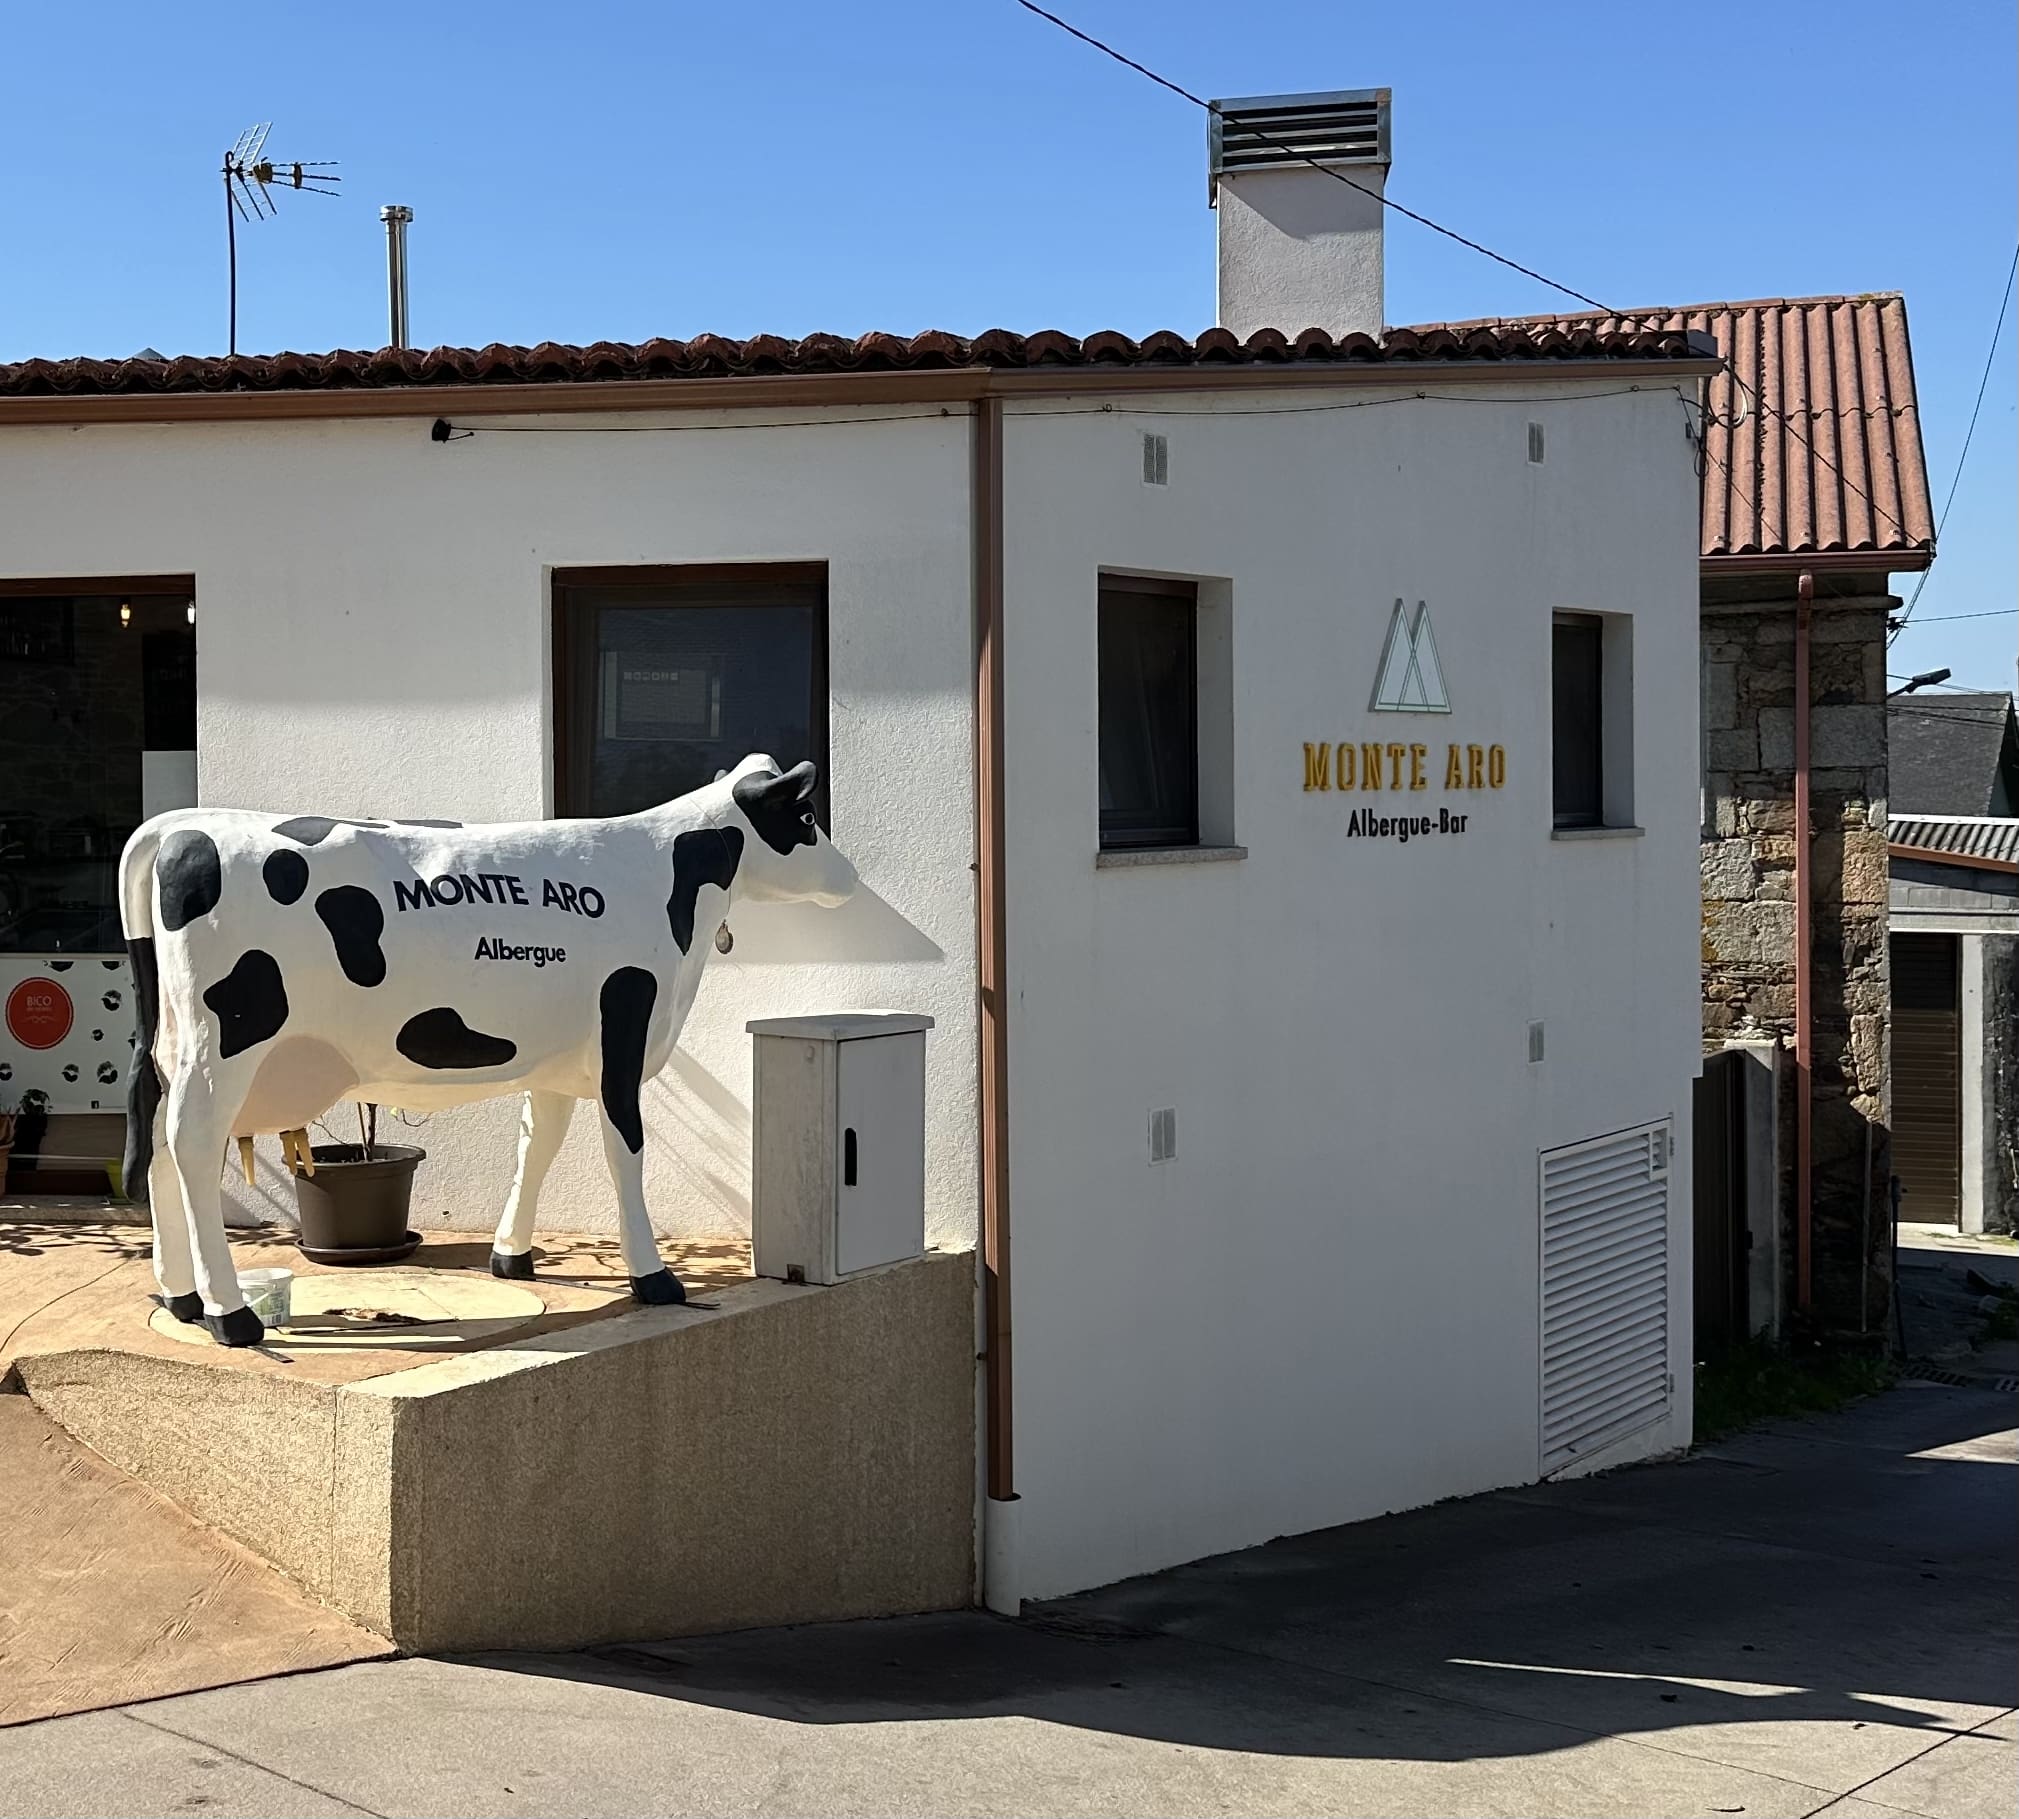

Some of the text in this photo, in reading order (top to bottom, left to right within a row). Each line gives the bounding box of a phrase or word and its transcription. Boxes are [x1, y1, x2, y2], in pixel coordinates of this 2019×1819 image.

[1303, 742, 1506, 791] MONTE ARO
[1347, 808, 1468, 842] Albergue-Bar
[393, 874, 605, 918] MONTE ARO
[474, 937, 566, 968] Albergue
